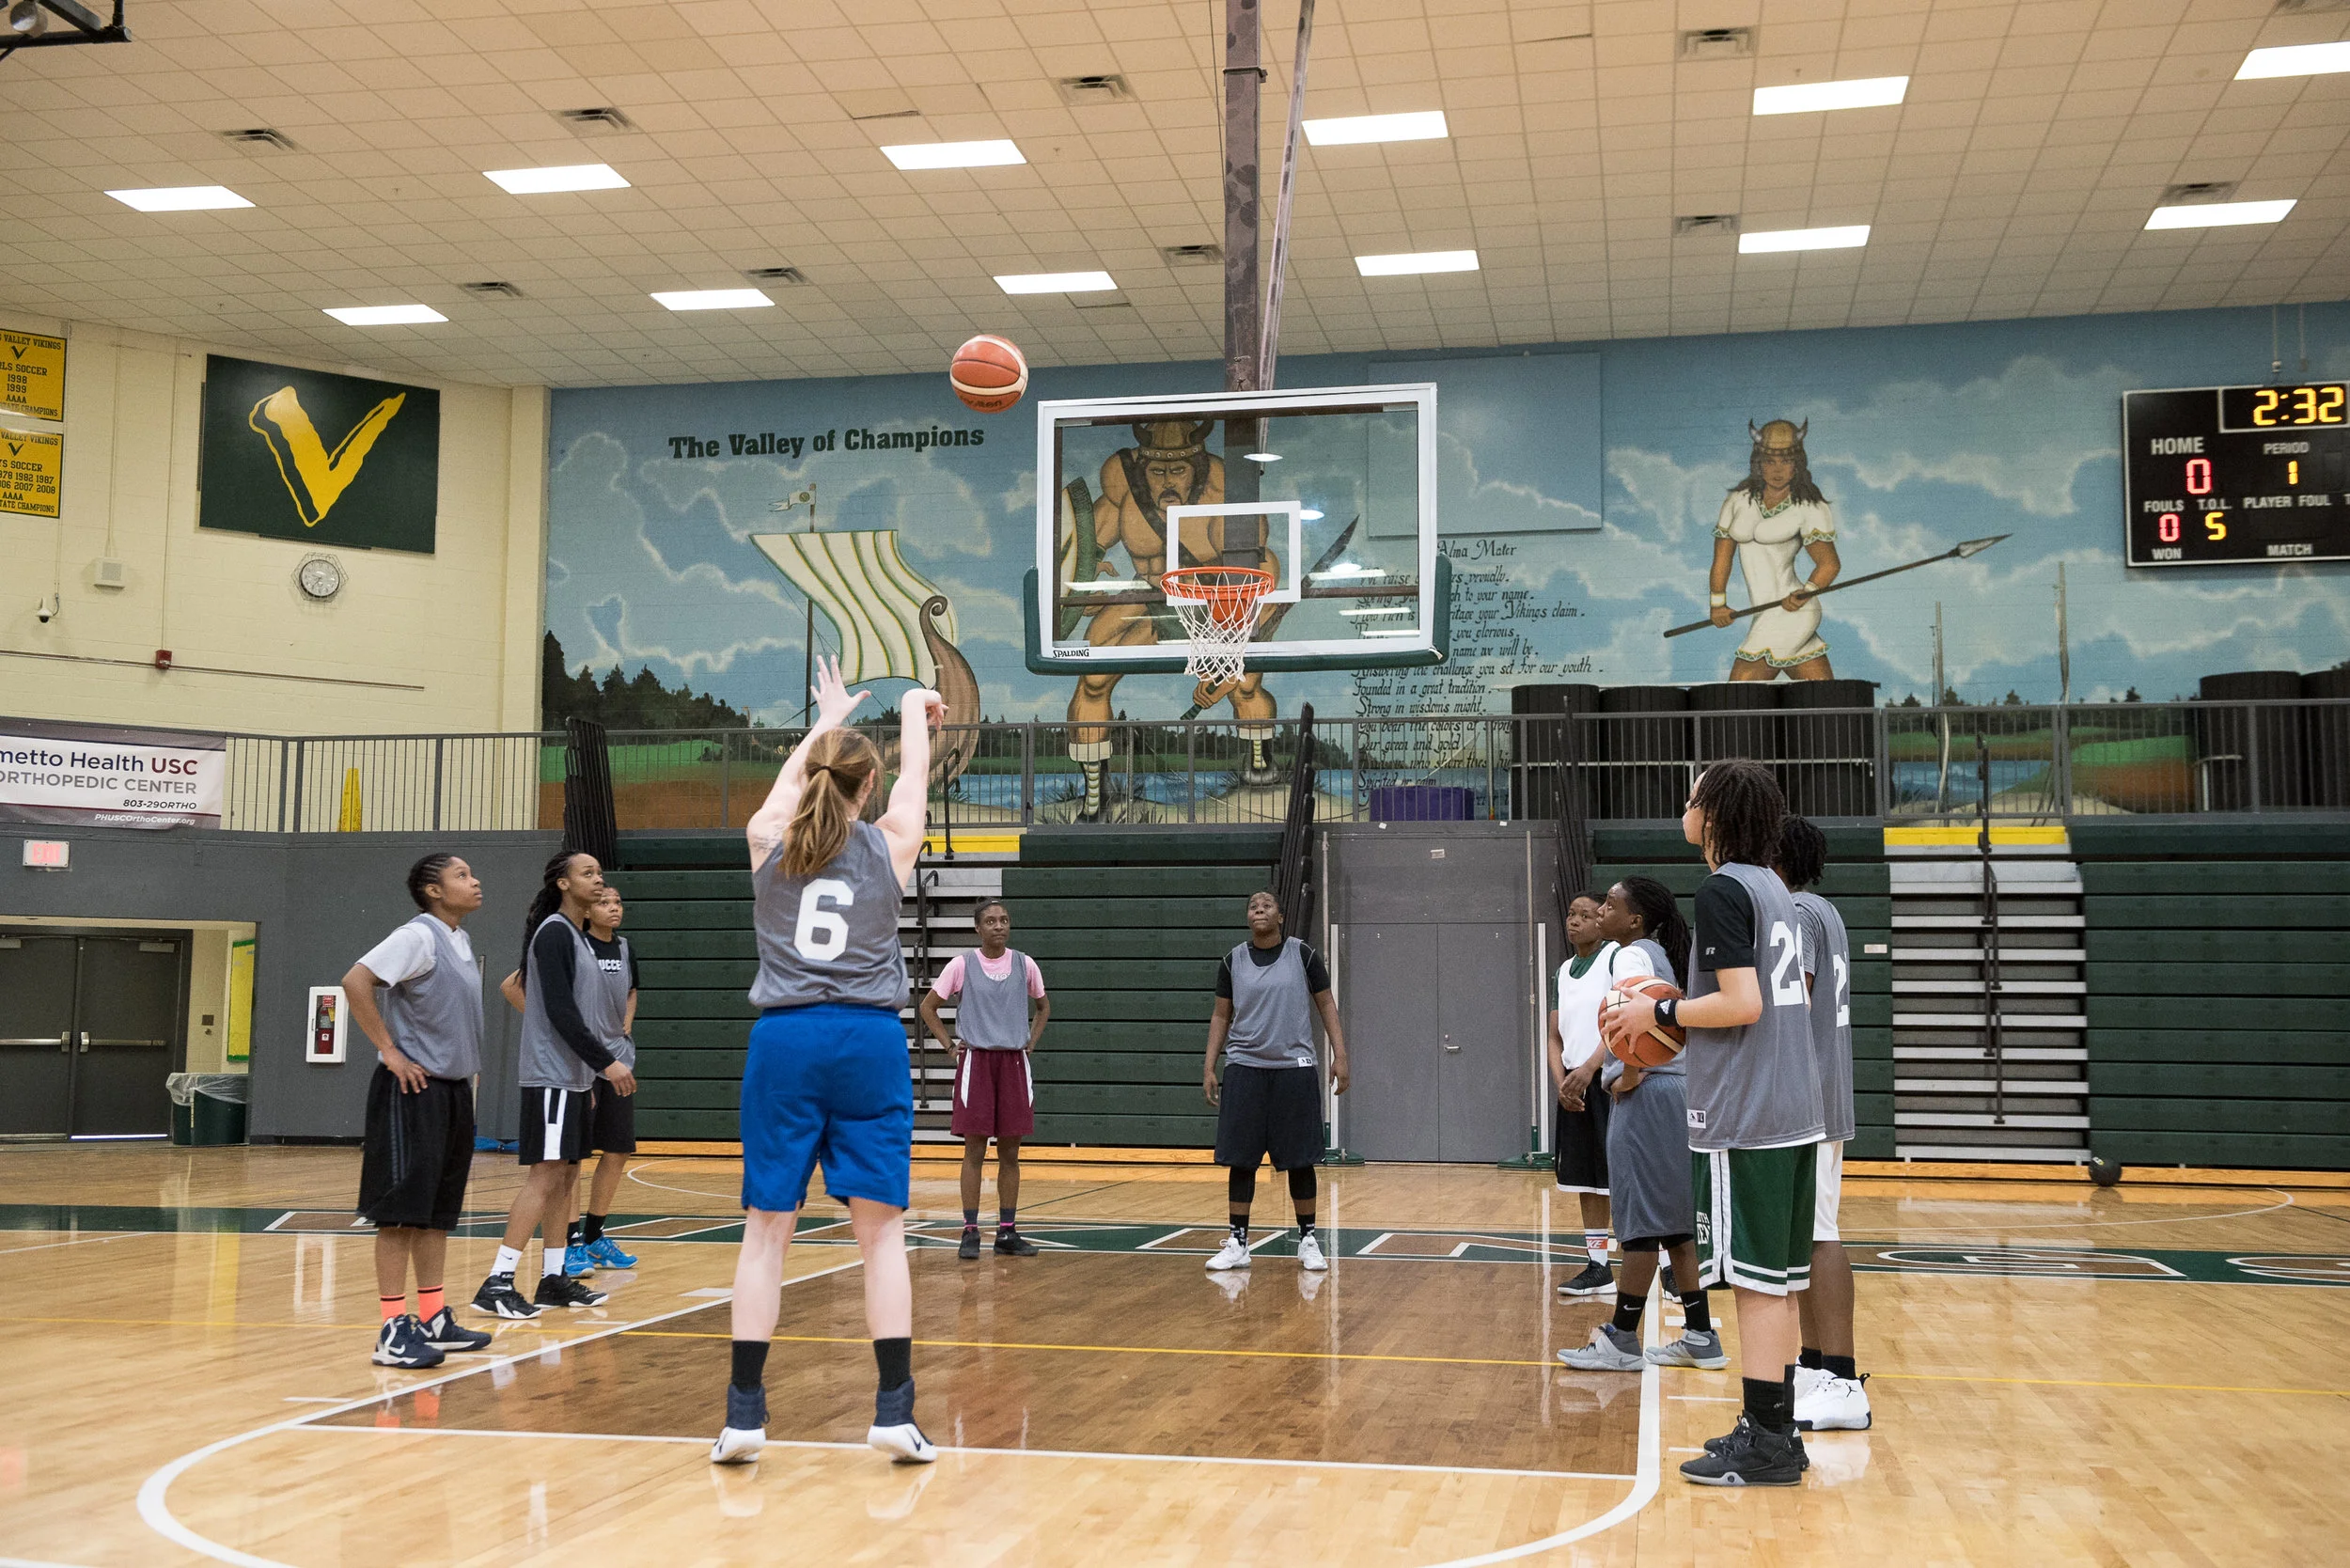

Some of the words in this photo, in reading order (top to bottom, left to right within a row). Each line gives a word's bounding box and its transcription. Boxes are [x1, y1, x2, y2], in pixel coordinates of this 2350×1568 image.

[4, 334, 30, 345] VALLEY
[33, 338, 61, 350] VIKINGS
[8, 374, 27, 384] 1998
[15, 364, 47, 376] SOCCER
[7, 384, 26, 393] 1999
[6, 394, 26, 403] AAAA
[2253, 386, 2344, 426] 2:32
[21, 404, 58, 416] CHAMPIONS
[1, 431, 26, 442] VALLEY
[30, 434, 58, 446] VIKINGS
[668, 434, 720, 460] The
[728, 431, 806, 459] Valley
[812, 429, 836, 452] of
[844, 425, 985, 453] Champions
[2151, 436, 2205, 455] HOME
[2263, 442, 2310, 455] PERIOD
[10, 461, 42, 472] SOCCER
[15, 472, 34, 482] 1982
[36, 475, 55, 484] 1987
[2186, 459, 2212, 494] 0
[2288, 460, 2298, 485] 1
[2, 491, 24, 500] AAAA
[14, 481, 34, 492] 2007
[36, 484, 56, 494] 2008
[17, 501, 55, 513] CHAMPIONS
[2144, 499, 2185, 512] FOULS
[2197, 498, 2232, 510] T.O.L.
[2243, 495, 2293, 509] PLAYER
[2298, 494, 2332, 507] FOUL
[2159, 513, 2180, 542] 0
[2205, 511, 2227, 541] 5
[1437, 540, 1468, 558] Alma
[1471, 539, 1517, 559] Mater
[2152, 548, 2182, 559] WON
[2267, 543, 2313, 556] MATCH
[1465, 565, 1510, 586] proudly.
[1465, 587, 1473, 598] to
[1474, 590, 1497, 604] your
[1501, 589, 1534, 601] name.
[1475, 609, 1499, 624] your
[1501, 600, 1547, 622] Vikings
[1452, 628, 1472, 642] you
[1472, 621, 1520, 642] glorious.
[1053, 649, 1089, 658] SPALDING
[1452, 647, 1477, 657] name
[1480, 647, 1494, 656] we
[1499, 638, 1519, 656] will
[1522, 638, 1539, 657] be.
[1433, 658, 1474, 679] challenge
[1476, 664, 1495, 679] you
[1500, 659, 1514, 674] set
[1517, 656, 1536, 674] for
[1539, 664, 1558, 674] our
[1353, 677, 1392, 697] Founded
[1396, 681, 1405, 695] in
[1410, 684, 1418, 695] a
[1418, 678, 1444, 698] great
[1448, 679, 1492, 695] tradition.
[1355, 696, 1390, 717] Strong
[1395, 699, 1404, 713] in
[1453, 694, 1487, 715] might.
[1413, 733, 1434, 751] and
[70, 751, 144, 772] Health
[151, 757, 198, 776] USC
[0, 770, 118, 790] RTHOPEDIC
[124, 778, 197, 794] CENTER
[123, 799, 197, 810] 803-29ORTHO
[95, 813, 196, 826] PHUSCOrthoCenter.org
[33, 842, 62, 864] EXIT
[793, 878, 854, 962] 6
[1769, 920, 1810, 1007] 2
